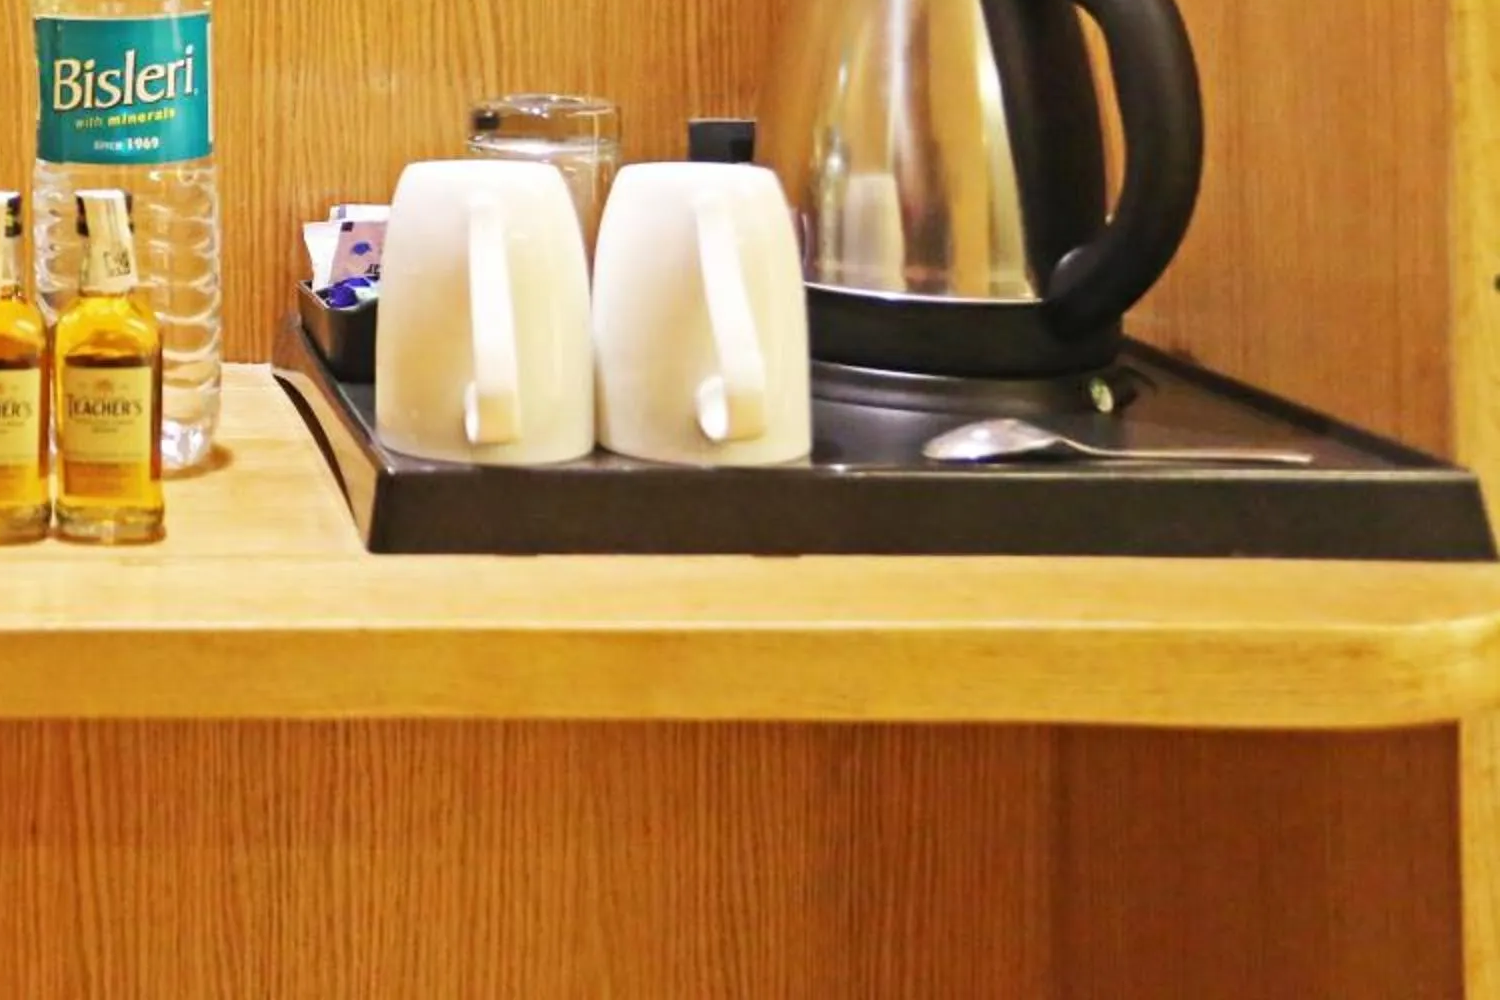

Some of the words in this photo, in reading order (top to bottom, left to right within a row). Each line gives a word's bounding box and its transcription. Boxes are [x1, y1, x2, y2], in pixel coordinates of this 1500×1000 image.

[53, 44, 194, 111] Bisleri
[75, 115, 103, 130] with
[107, 107, 176, 128] minerals
[127, 136, 160, 150] 1969
